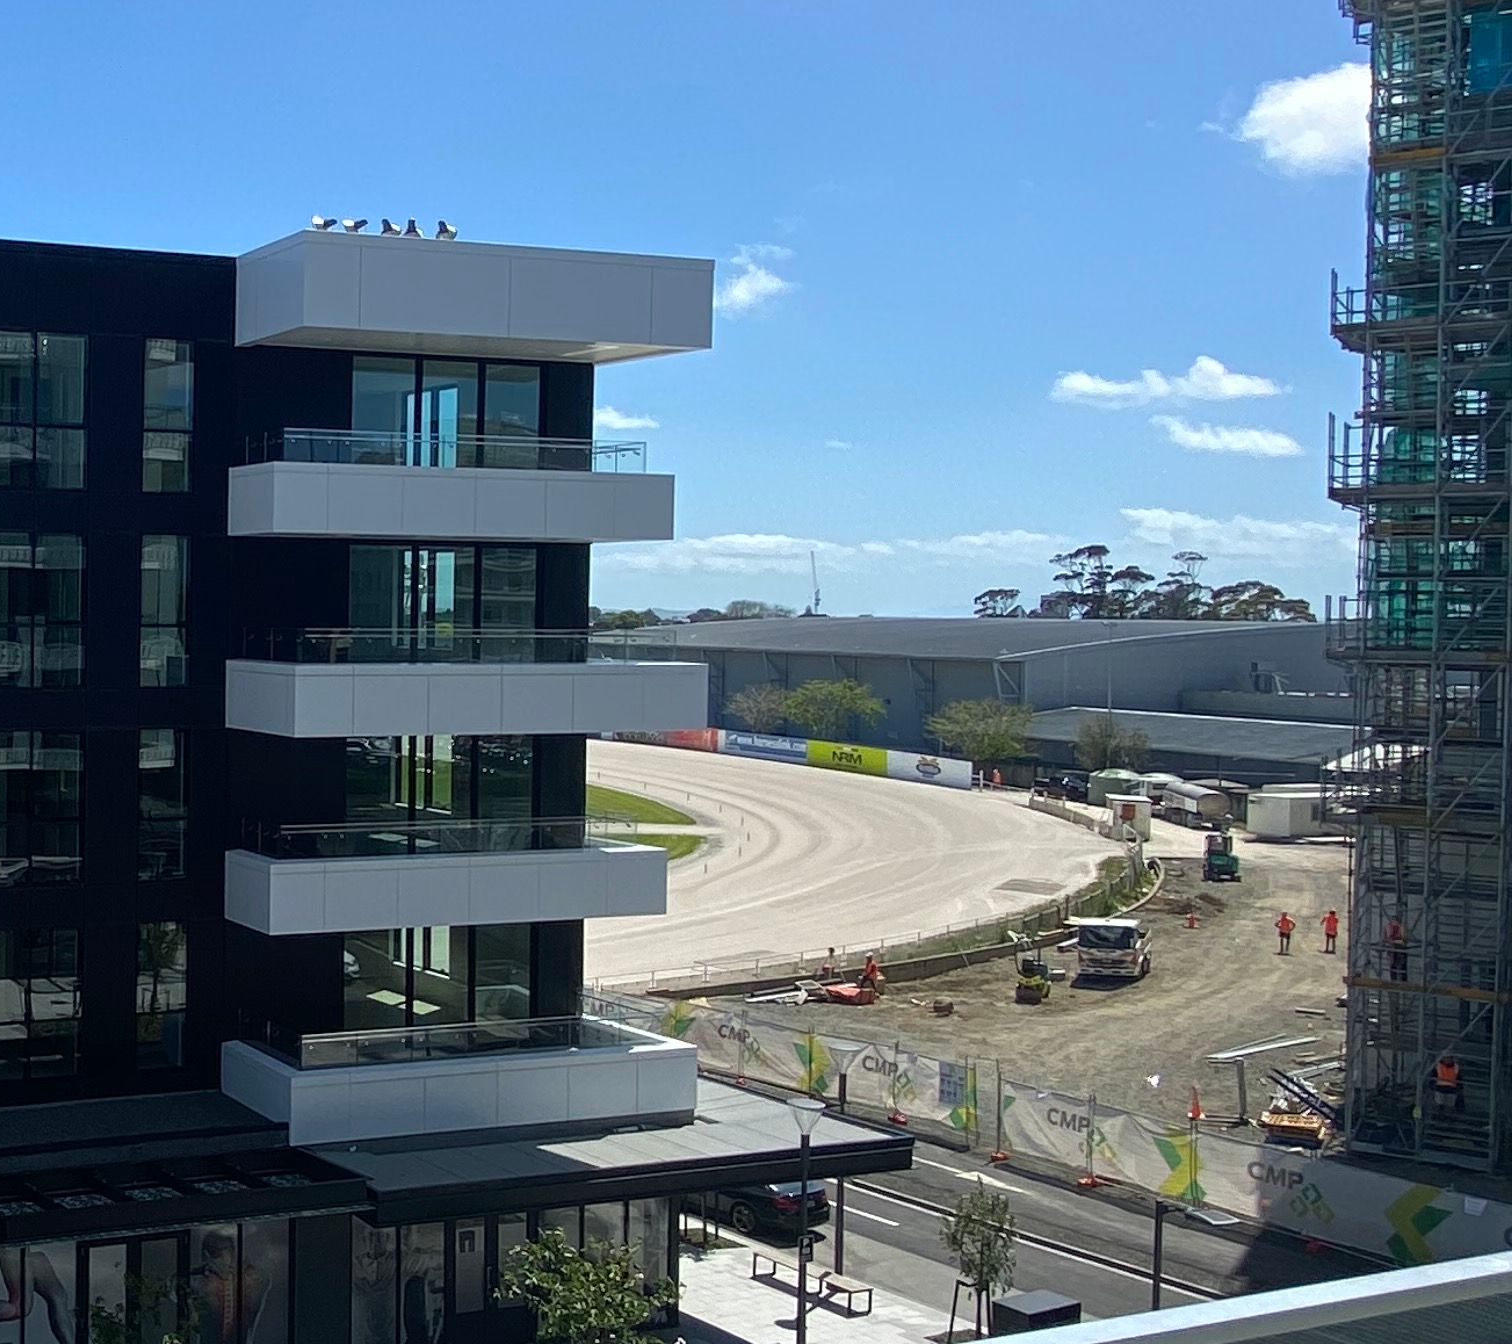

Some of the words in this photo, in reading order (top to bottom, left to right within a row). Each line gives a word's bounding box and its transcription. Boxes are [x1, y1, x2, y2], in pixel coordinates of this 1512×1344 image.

[832, 750, 862, 766] NRM
[591, 999, 615, 1017] MP
[718, 1024, 750, 1043] CMP
[862, 1055, 899, 1077] CMP
[1047, 1108, 1091, 1133] CMP
[1247, 1161, 1304, 1190] CMP
